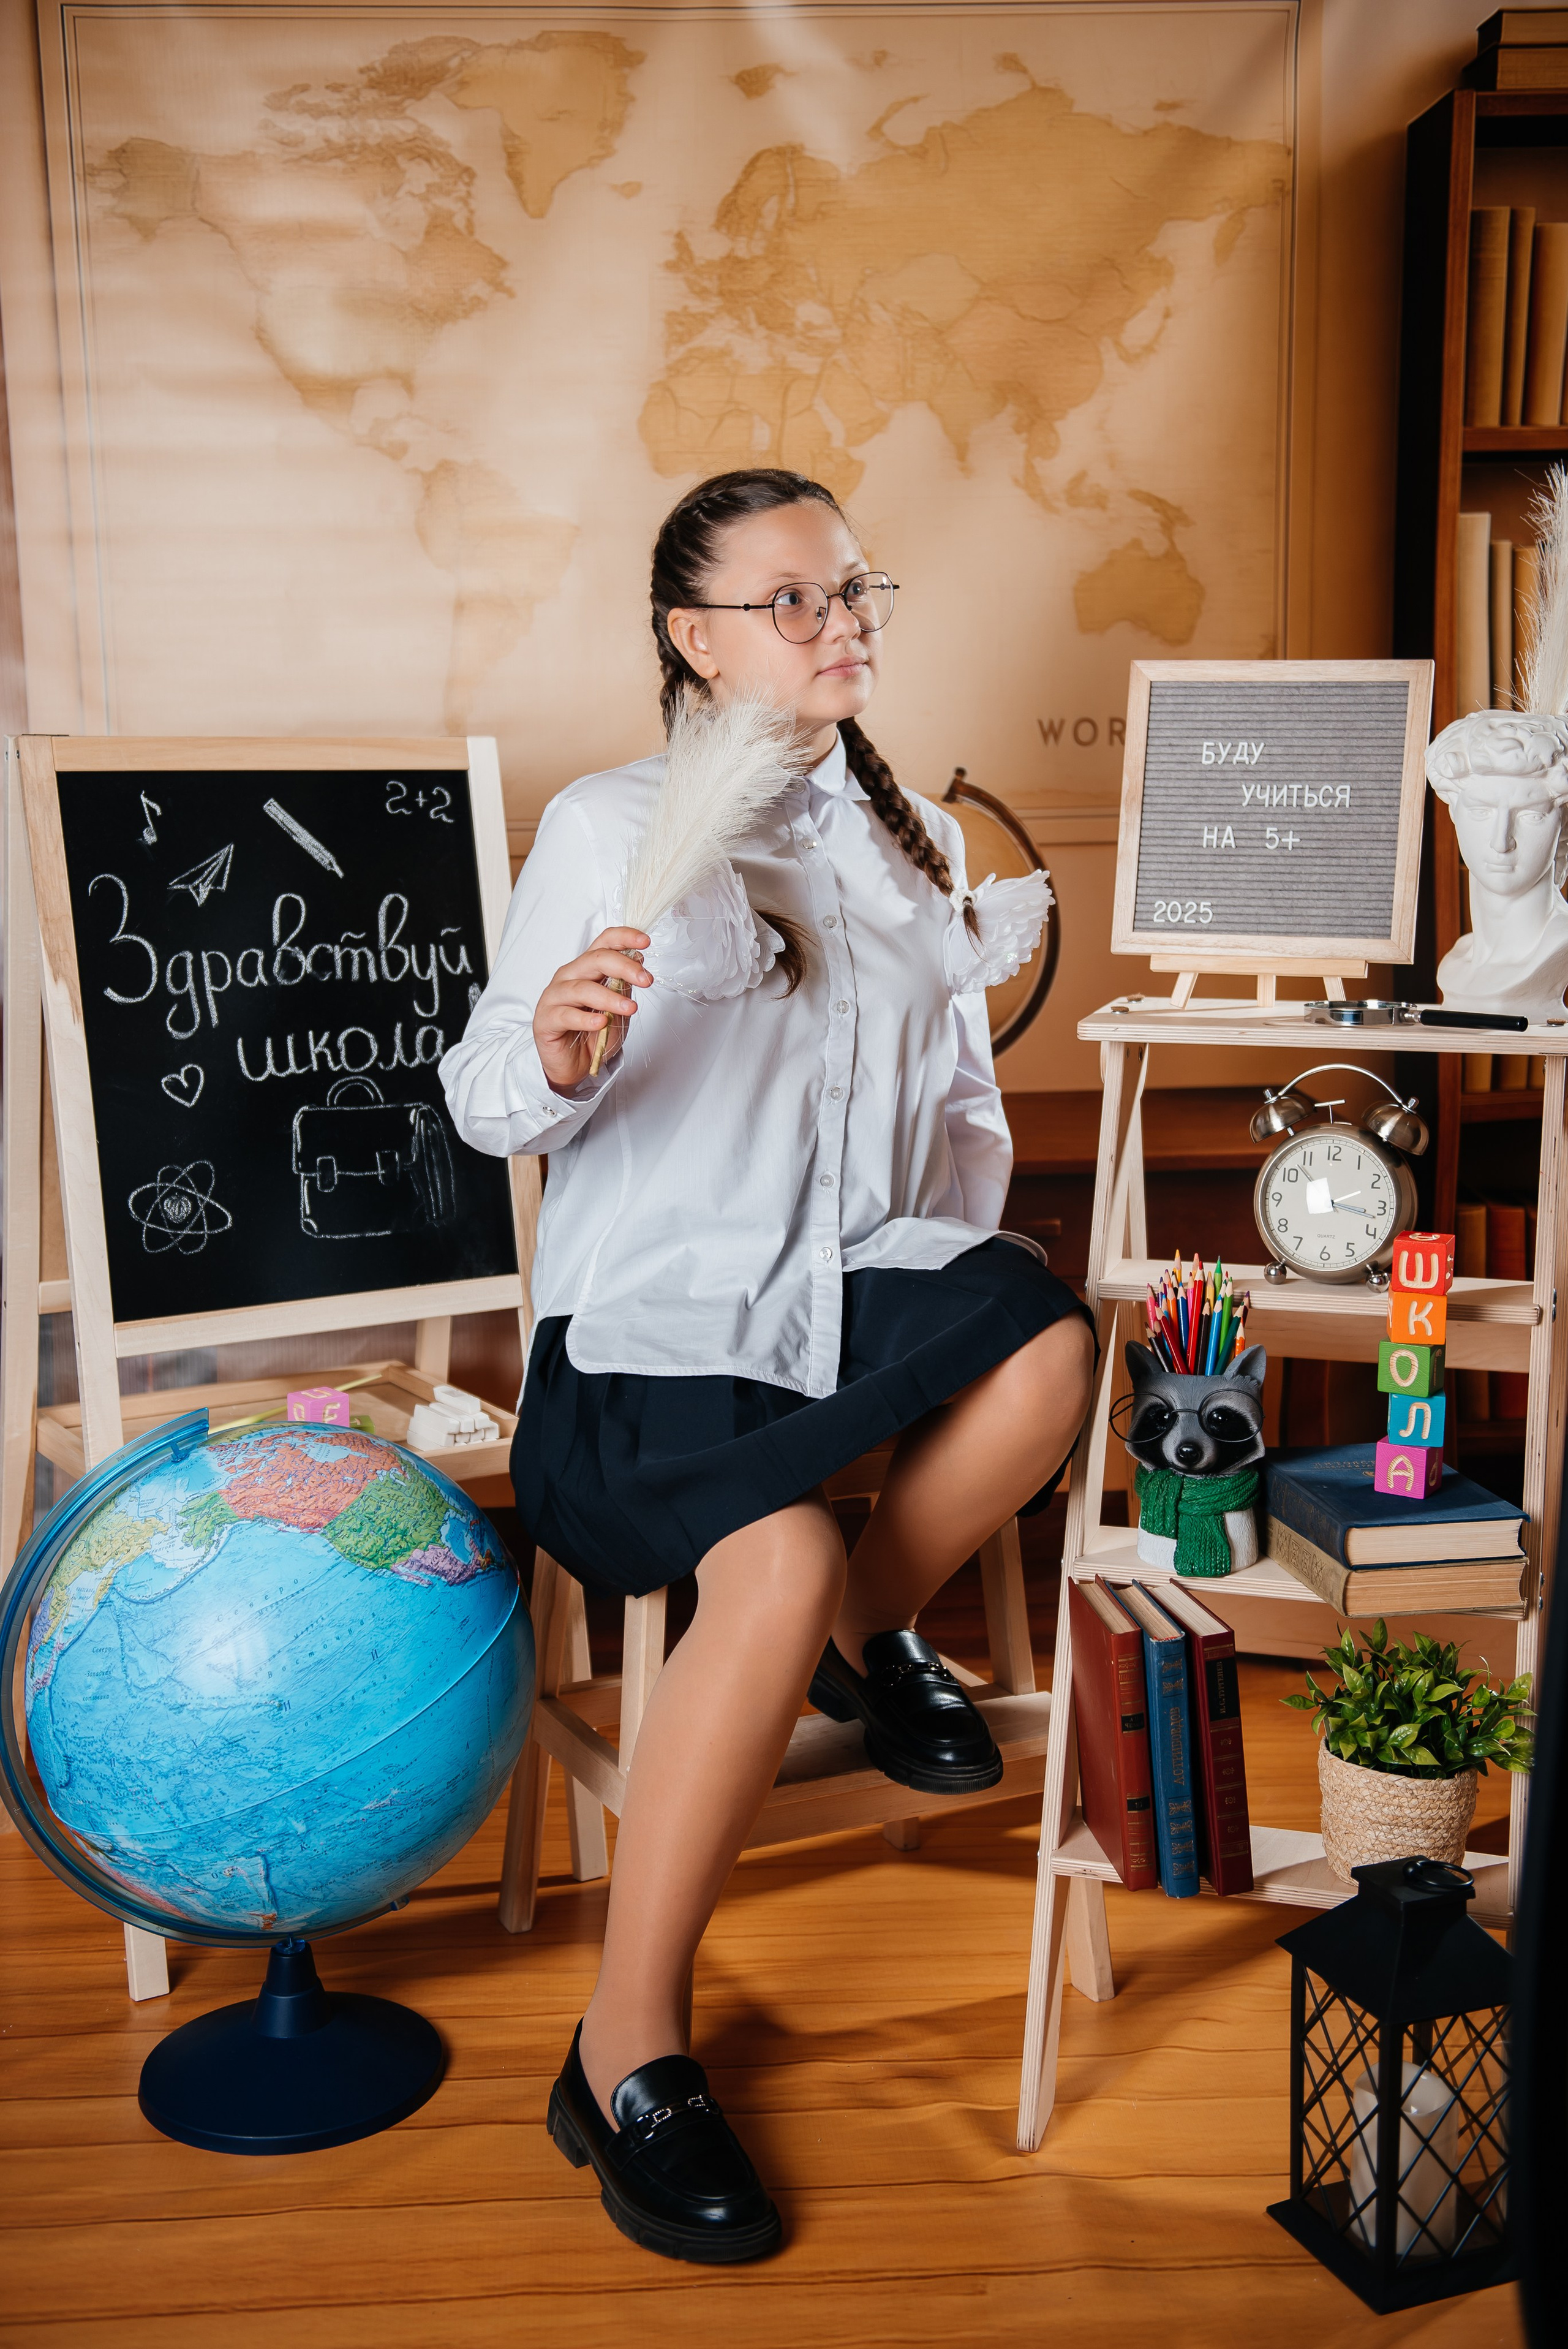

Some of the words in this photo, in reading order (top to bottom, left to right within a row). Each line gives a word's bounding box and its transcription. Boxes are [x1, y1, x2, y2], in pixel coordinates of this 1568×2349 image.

[1202, 741, 1265, 765] БУДУ
[386, 781, 453, 823] 2+2
[1242, 784, 1351, 808] УЧИТЬСЯ
[1203, 825, 1236, 849] НА
[1265, 827, 1300, 850] 5+
[1153, 901, 1213, 923] 2025
[89, 874, 474, 1040] Здравствуй
[238, 1022, 445, 1081] школа
[1303, 1151, 1313, 1166] 11
[1327, 1146, 1342, 1161] 12
[1357, 1155, 1361, 1170] 1
[1283, 1167, 1298, 1182] 10
[1371, 1174, 1381, 1189] 2
[1272, 1192, 1283, 1208] 9
[1377, 1200, 1387, 1216] 3
[1277, 1218, 1289, 1233] 8
[1365, 1224, 1377, 1239] 4
[1293, 1236, 1303, 1251] 7
[1345, 1243, 1355, 1257] 5
[1319, 1246, 1331, 1261] 6
